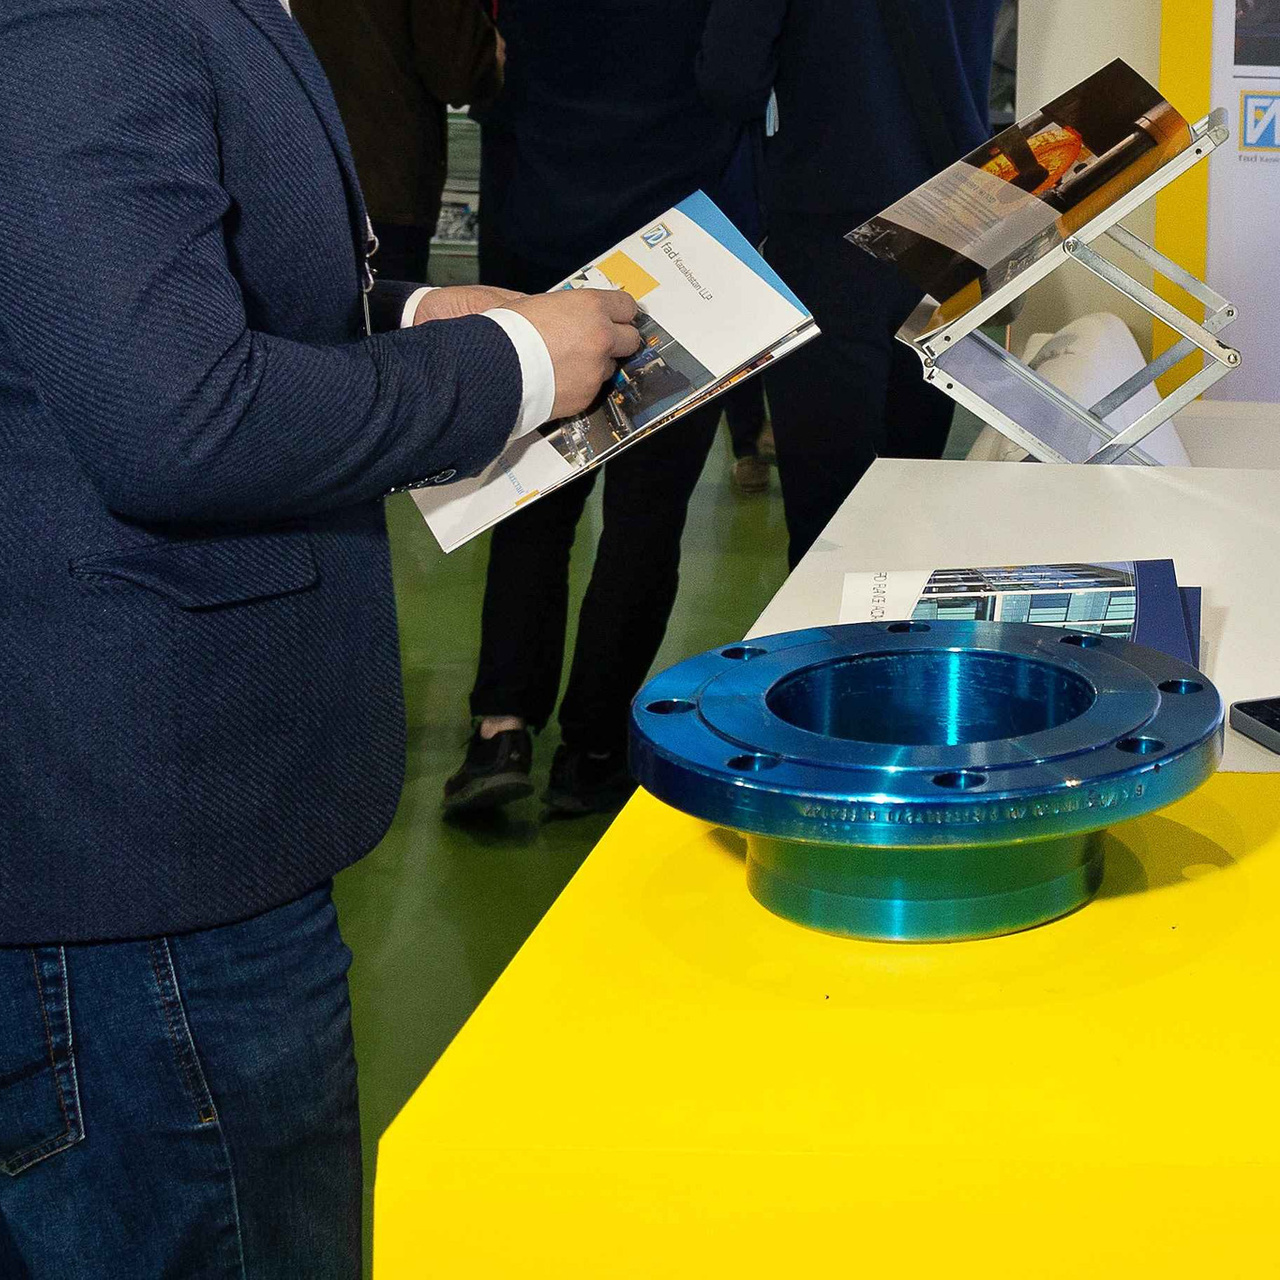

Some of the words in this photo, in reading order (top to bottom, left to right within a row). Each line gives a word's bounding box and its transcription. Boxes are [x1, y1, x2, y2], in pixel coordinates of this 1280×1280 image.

[661, 241, 680, 260] fad
[673, 256, 702, 291] Kazakhstan
[698, 287, 713, 301] LLP
